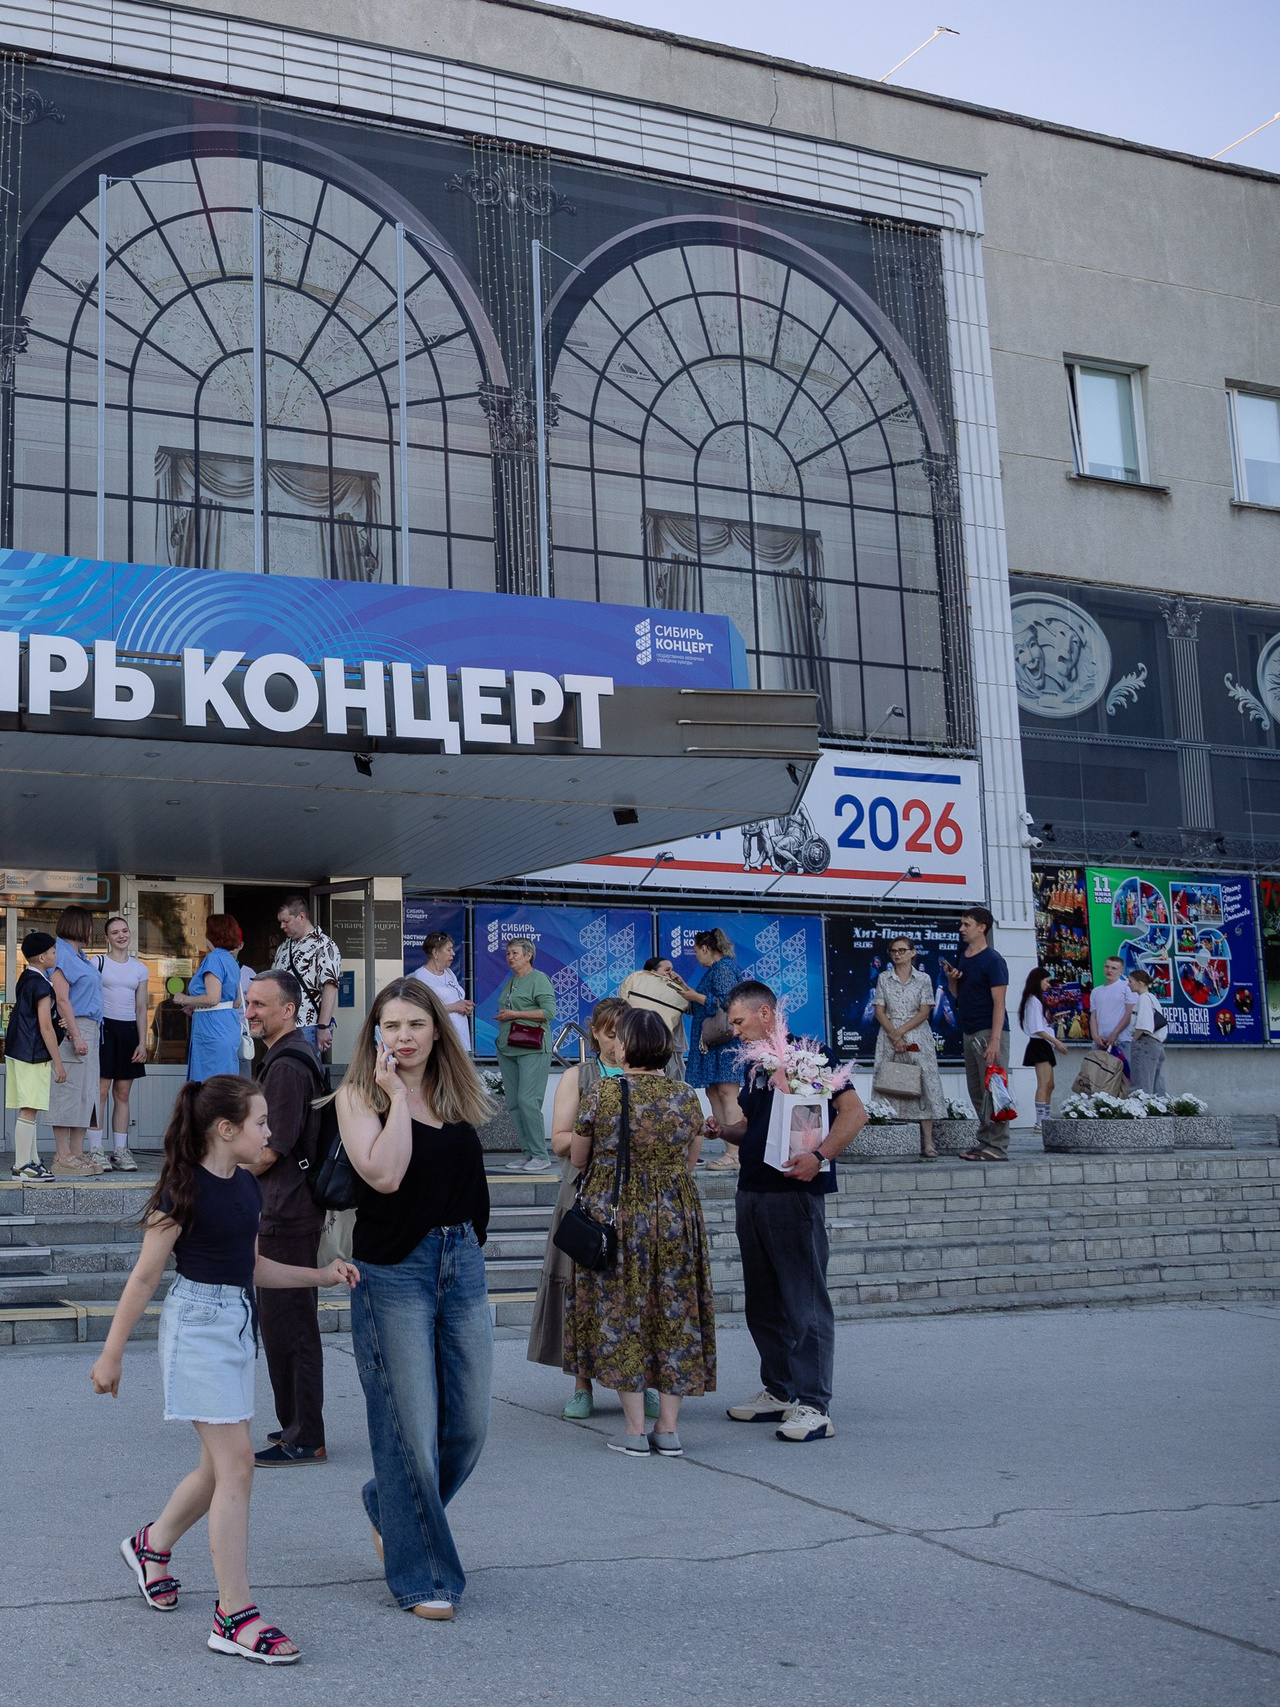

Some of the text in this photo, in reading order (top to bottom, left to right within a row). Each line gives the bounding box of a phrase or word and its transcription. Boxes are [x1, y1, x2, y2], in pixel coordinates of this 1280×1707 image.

[654, 625, 704, 640] СИБИРЬ
[655, 638, 714, 654] КОНЦЕРТ
[181, 647, 614, 755] КОНЦЕРТ
[834, 794, 963, 855] 2026
[1057, 869, 1077, 884] 82!
[1093, 876, 1111, 892] 11
[1095, 896, 1112, 904] 19:00
[501, 923, 535, 932] СИБИРЬ
[1188, 1007, 1210, 1023] ВЕКА
[1184, 1022, 1188, 1034] В
[1190, 1022, 1210, 1036] ТАНЦЕ
